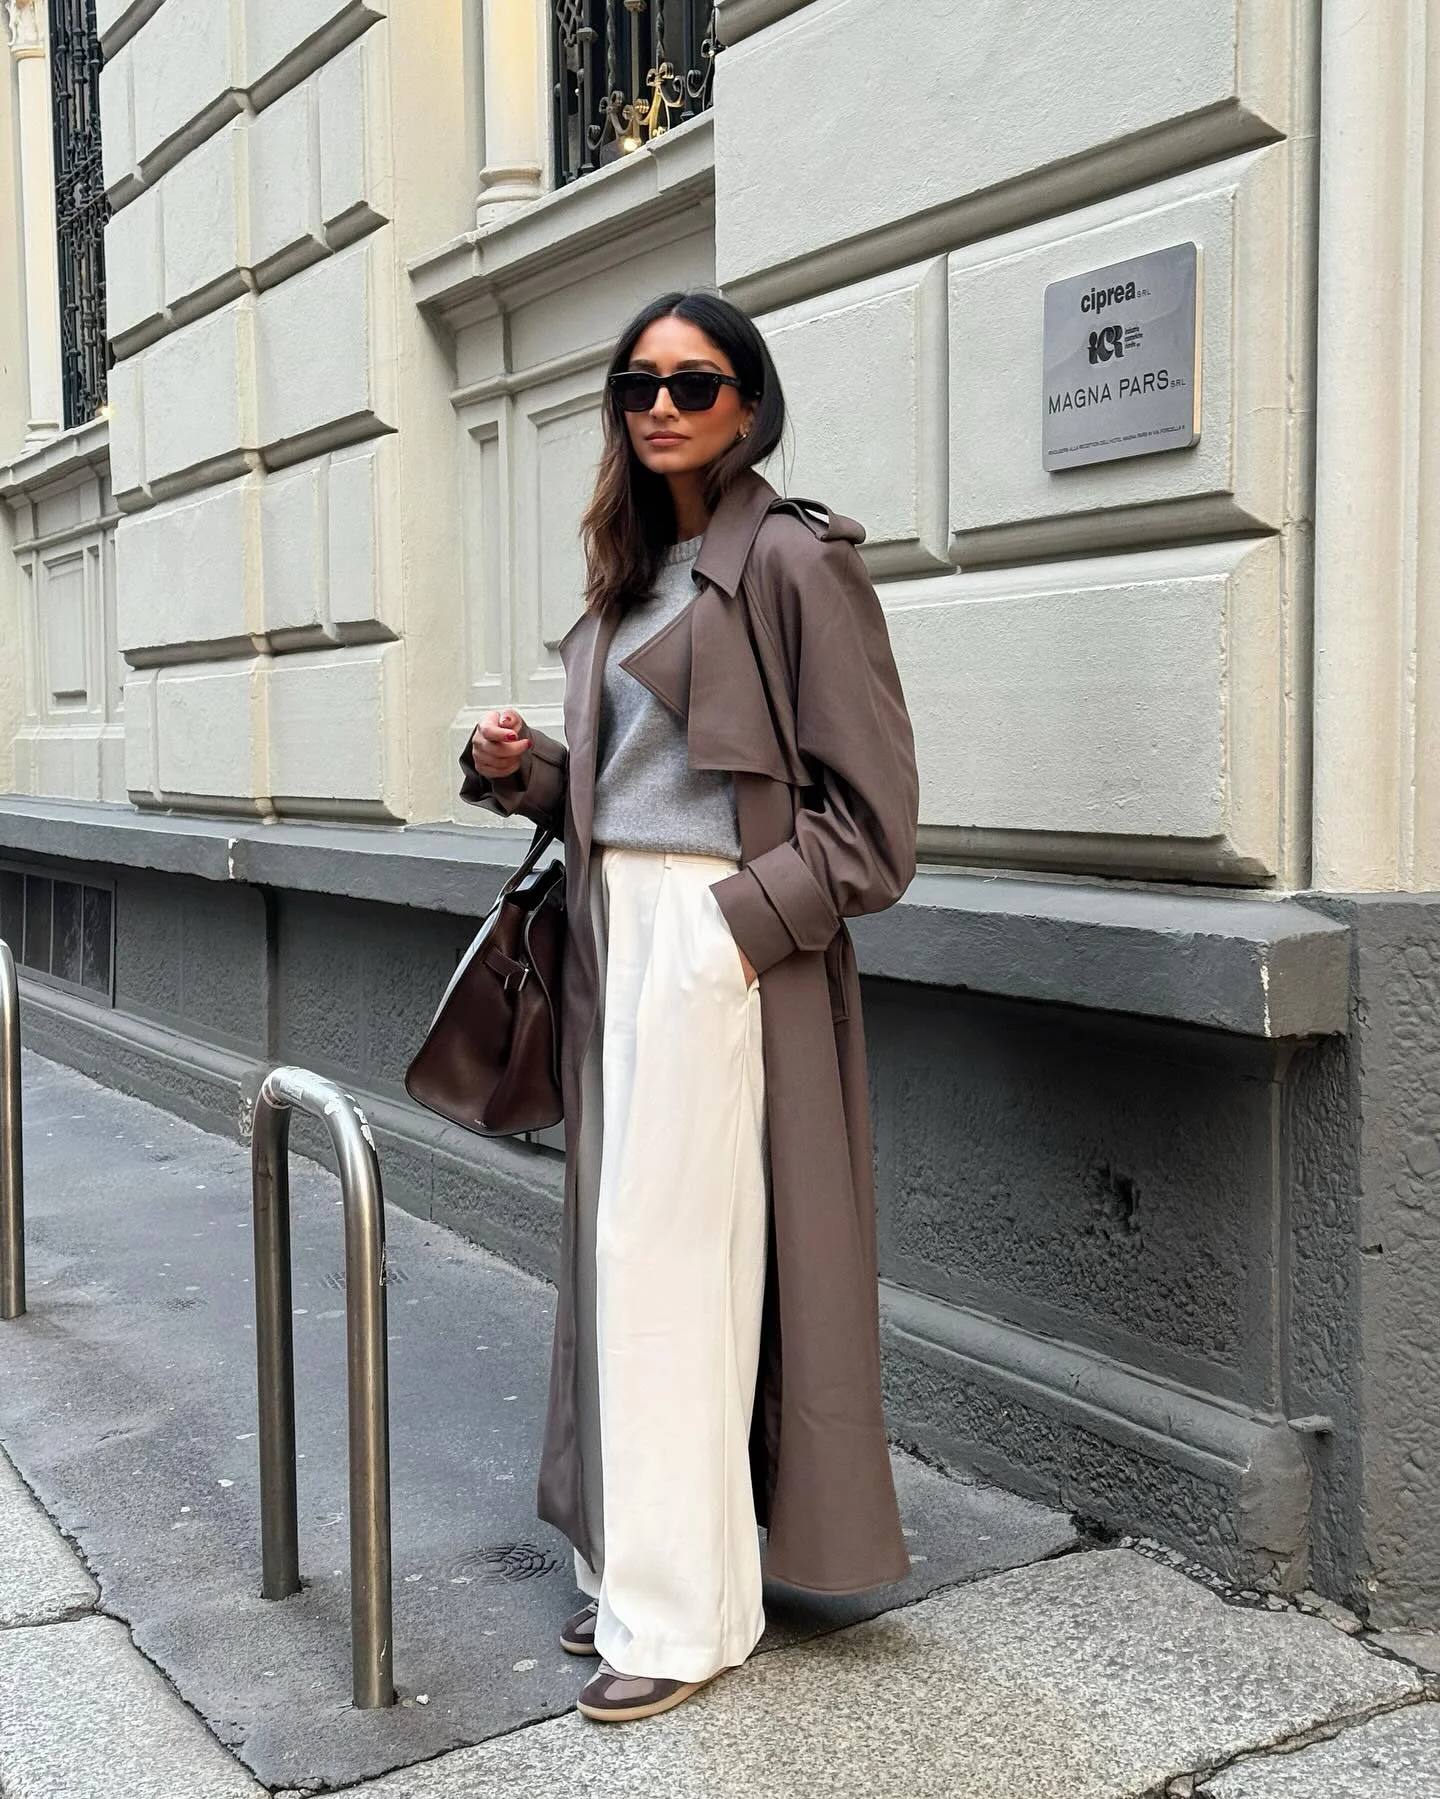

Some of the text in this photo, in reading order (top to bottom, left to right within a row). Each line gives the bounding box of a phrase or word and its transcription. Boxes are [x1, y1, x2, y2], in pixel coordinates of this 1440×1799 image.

[1081, 281, 1152, 314] ciprea SRL
[1048, 369, 1187, 415] MAGNA PARS SRL
